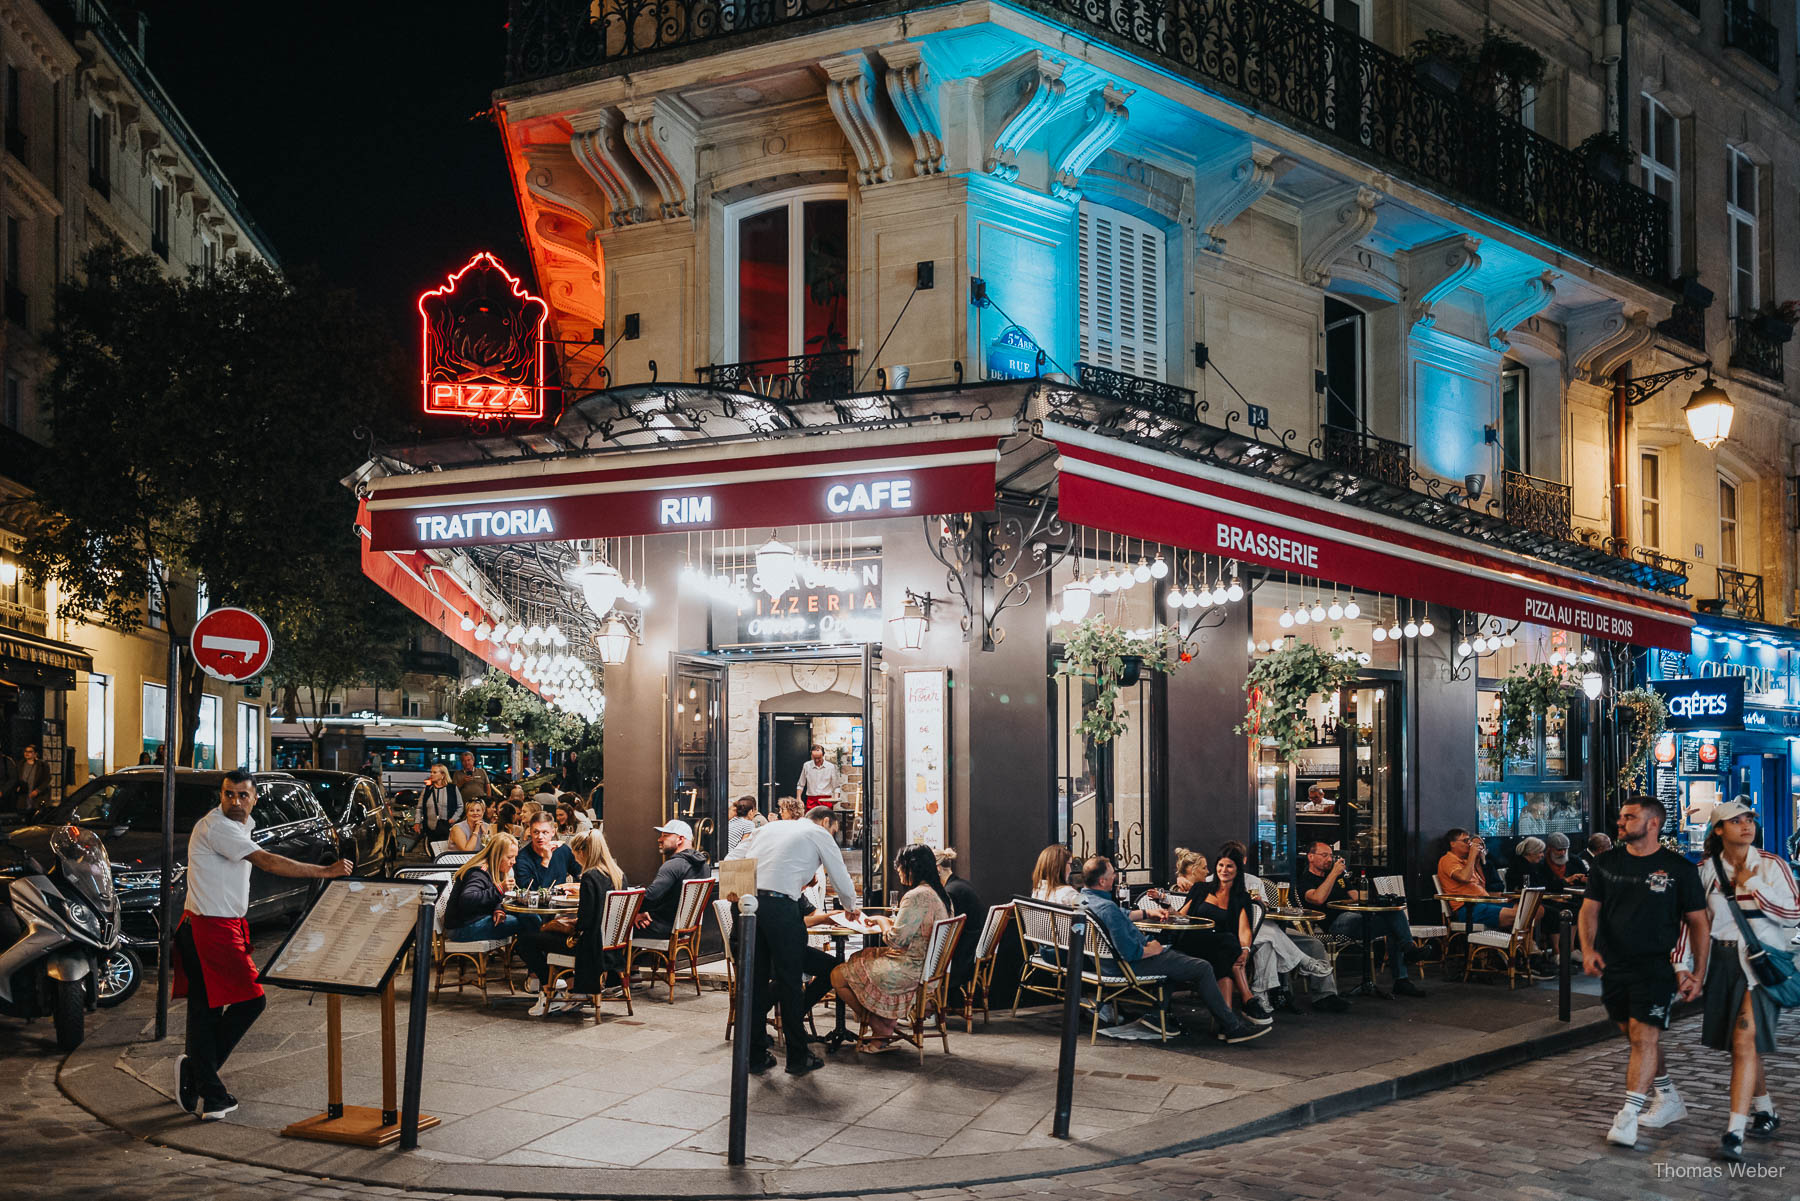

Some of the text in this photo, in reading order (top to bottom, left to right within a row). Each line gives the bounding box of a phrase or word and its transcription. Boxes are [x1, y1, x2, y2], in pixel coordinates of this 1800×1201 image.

[1009, 359, 1030, 373] RUE
[434, 385, 529, 406] PIZZA
[660, 497, 712, 524] RIM
[827, 480, 912, 513] CAFE
[416, 508, 554, 541] TRATTORIA
[1217, 523, 1318, 569] BRASSERIE
[737, 591, 877, 616] IZZERIA
[1525, 598, 1633, 637] PIZZA AU FEU DE BOIS
[1669, 690, 1727, 720] CRÊPES
